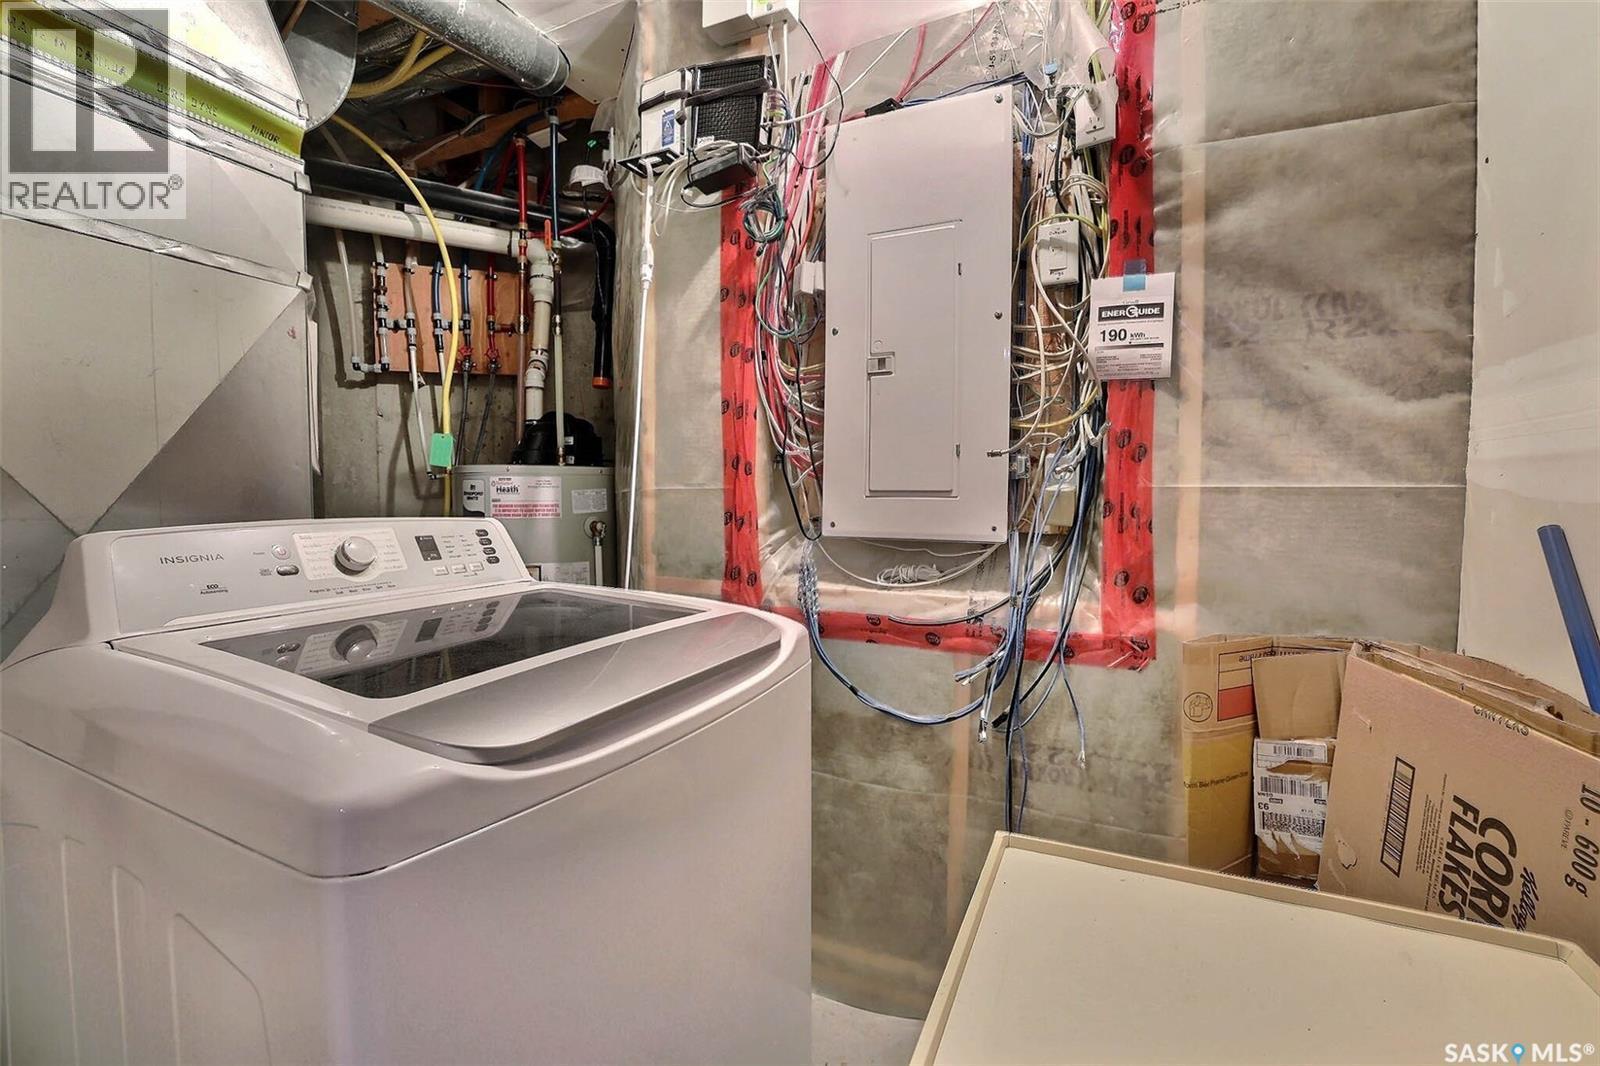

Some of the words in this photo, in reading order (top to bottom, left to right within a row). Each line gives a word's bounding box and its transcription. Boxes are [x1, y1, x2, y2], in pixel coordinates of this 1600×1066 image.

[251, 124, 281, 144] JUNIOR
[1101, 305, 1161, 318] ENERGUIDE
[1100, 328, 1128, 343] 190
[160, 553, 225, 565] INSIGNIA
[1257, 802, 1270, 811] 93
[1438, 794, 1481, 920] FLAKES
[1571, 834, 1600, 882] 600
[1564, 873, 1588, 898] g
